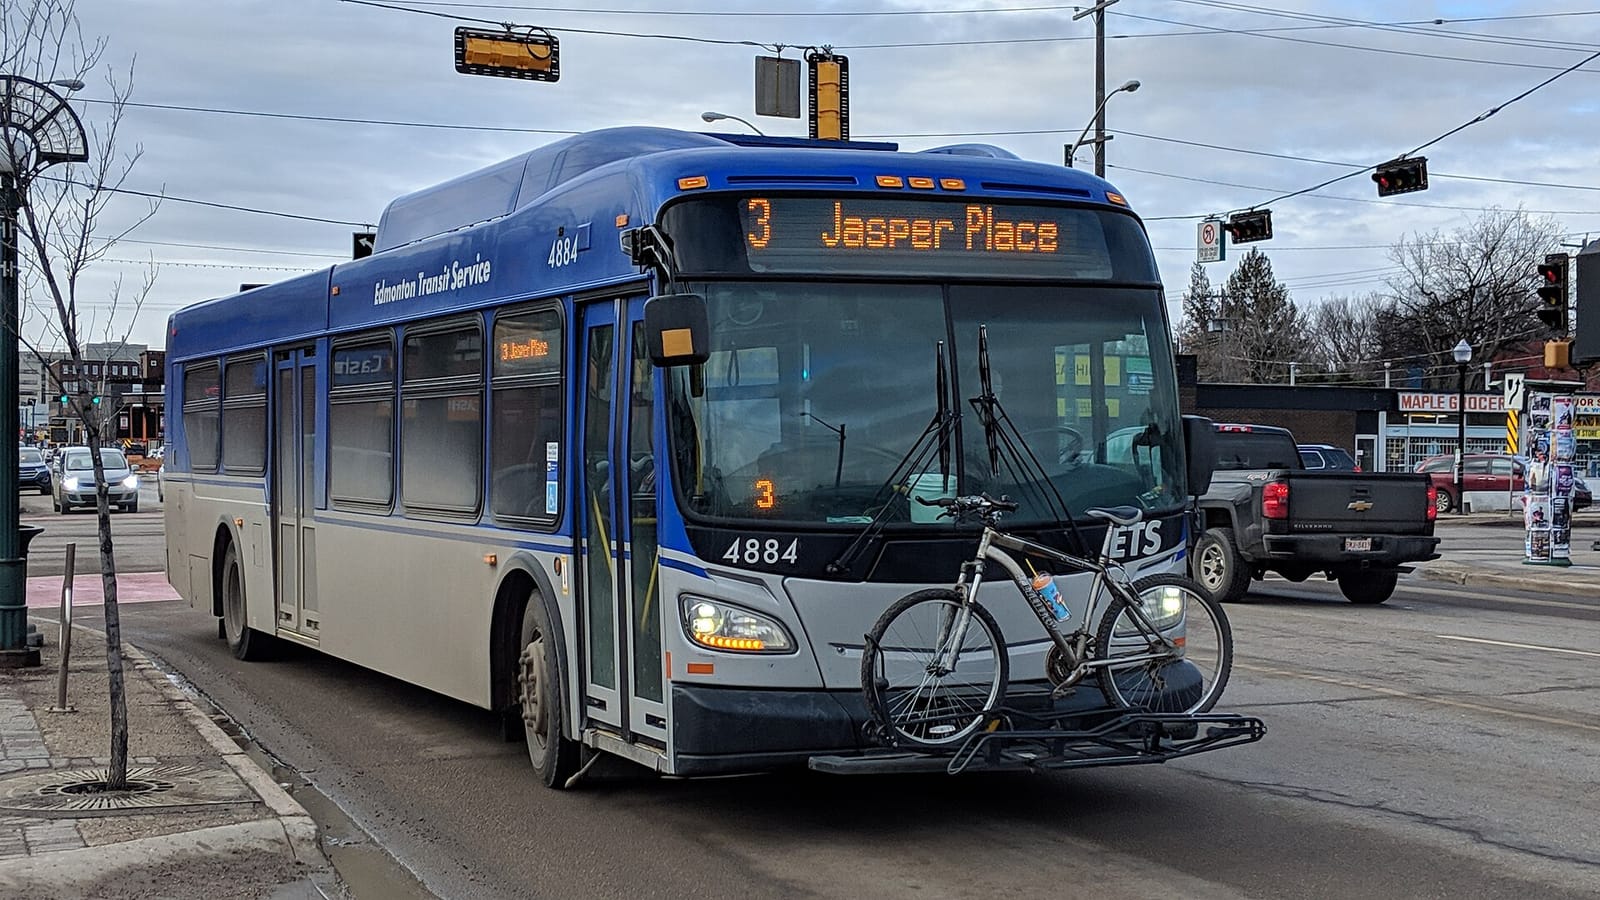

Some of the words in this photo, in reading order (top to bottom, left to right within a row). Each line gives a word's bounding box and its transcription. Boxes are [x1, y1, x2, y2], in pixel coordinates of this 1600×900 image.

[748, 199, 771, 248] 3
[821, 201, 954, 249] Jasper
[966, 204, 1058, 252] Place
[548, 233, 578, 268] 4884
[374, 278, 416, 306] Edmonton
[417, 265, 451, 297] Transit
[451, 252, 491, 290] Service
[502, 343, 509, 360] 3
[1402, 395, 1445, 409] MAPLE
[756, 480, 773, 508] 3
[722, 537, 798, 564] 4884
[1109, 520, 1162, 559] ETS
